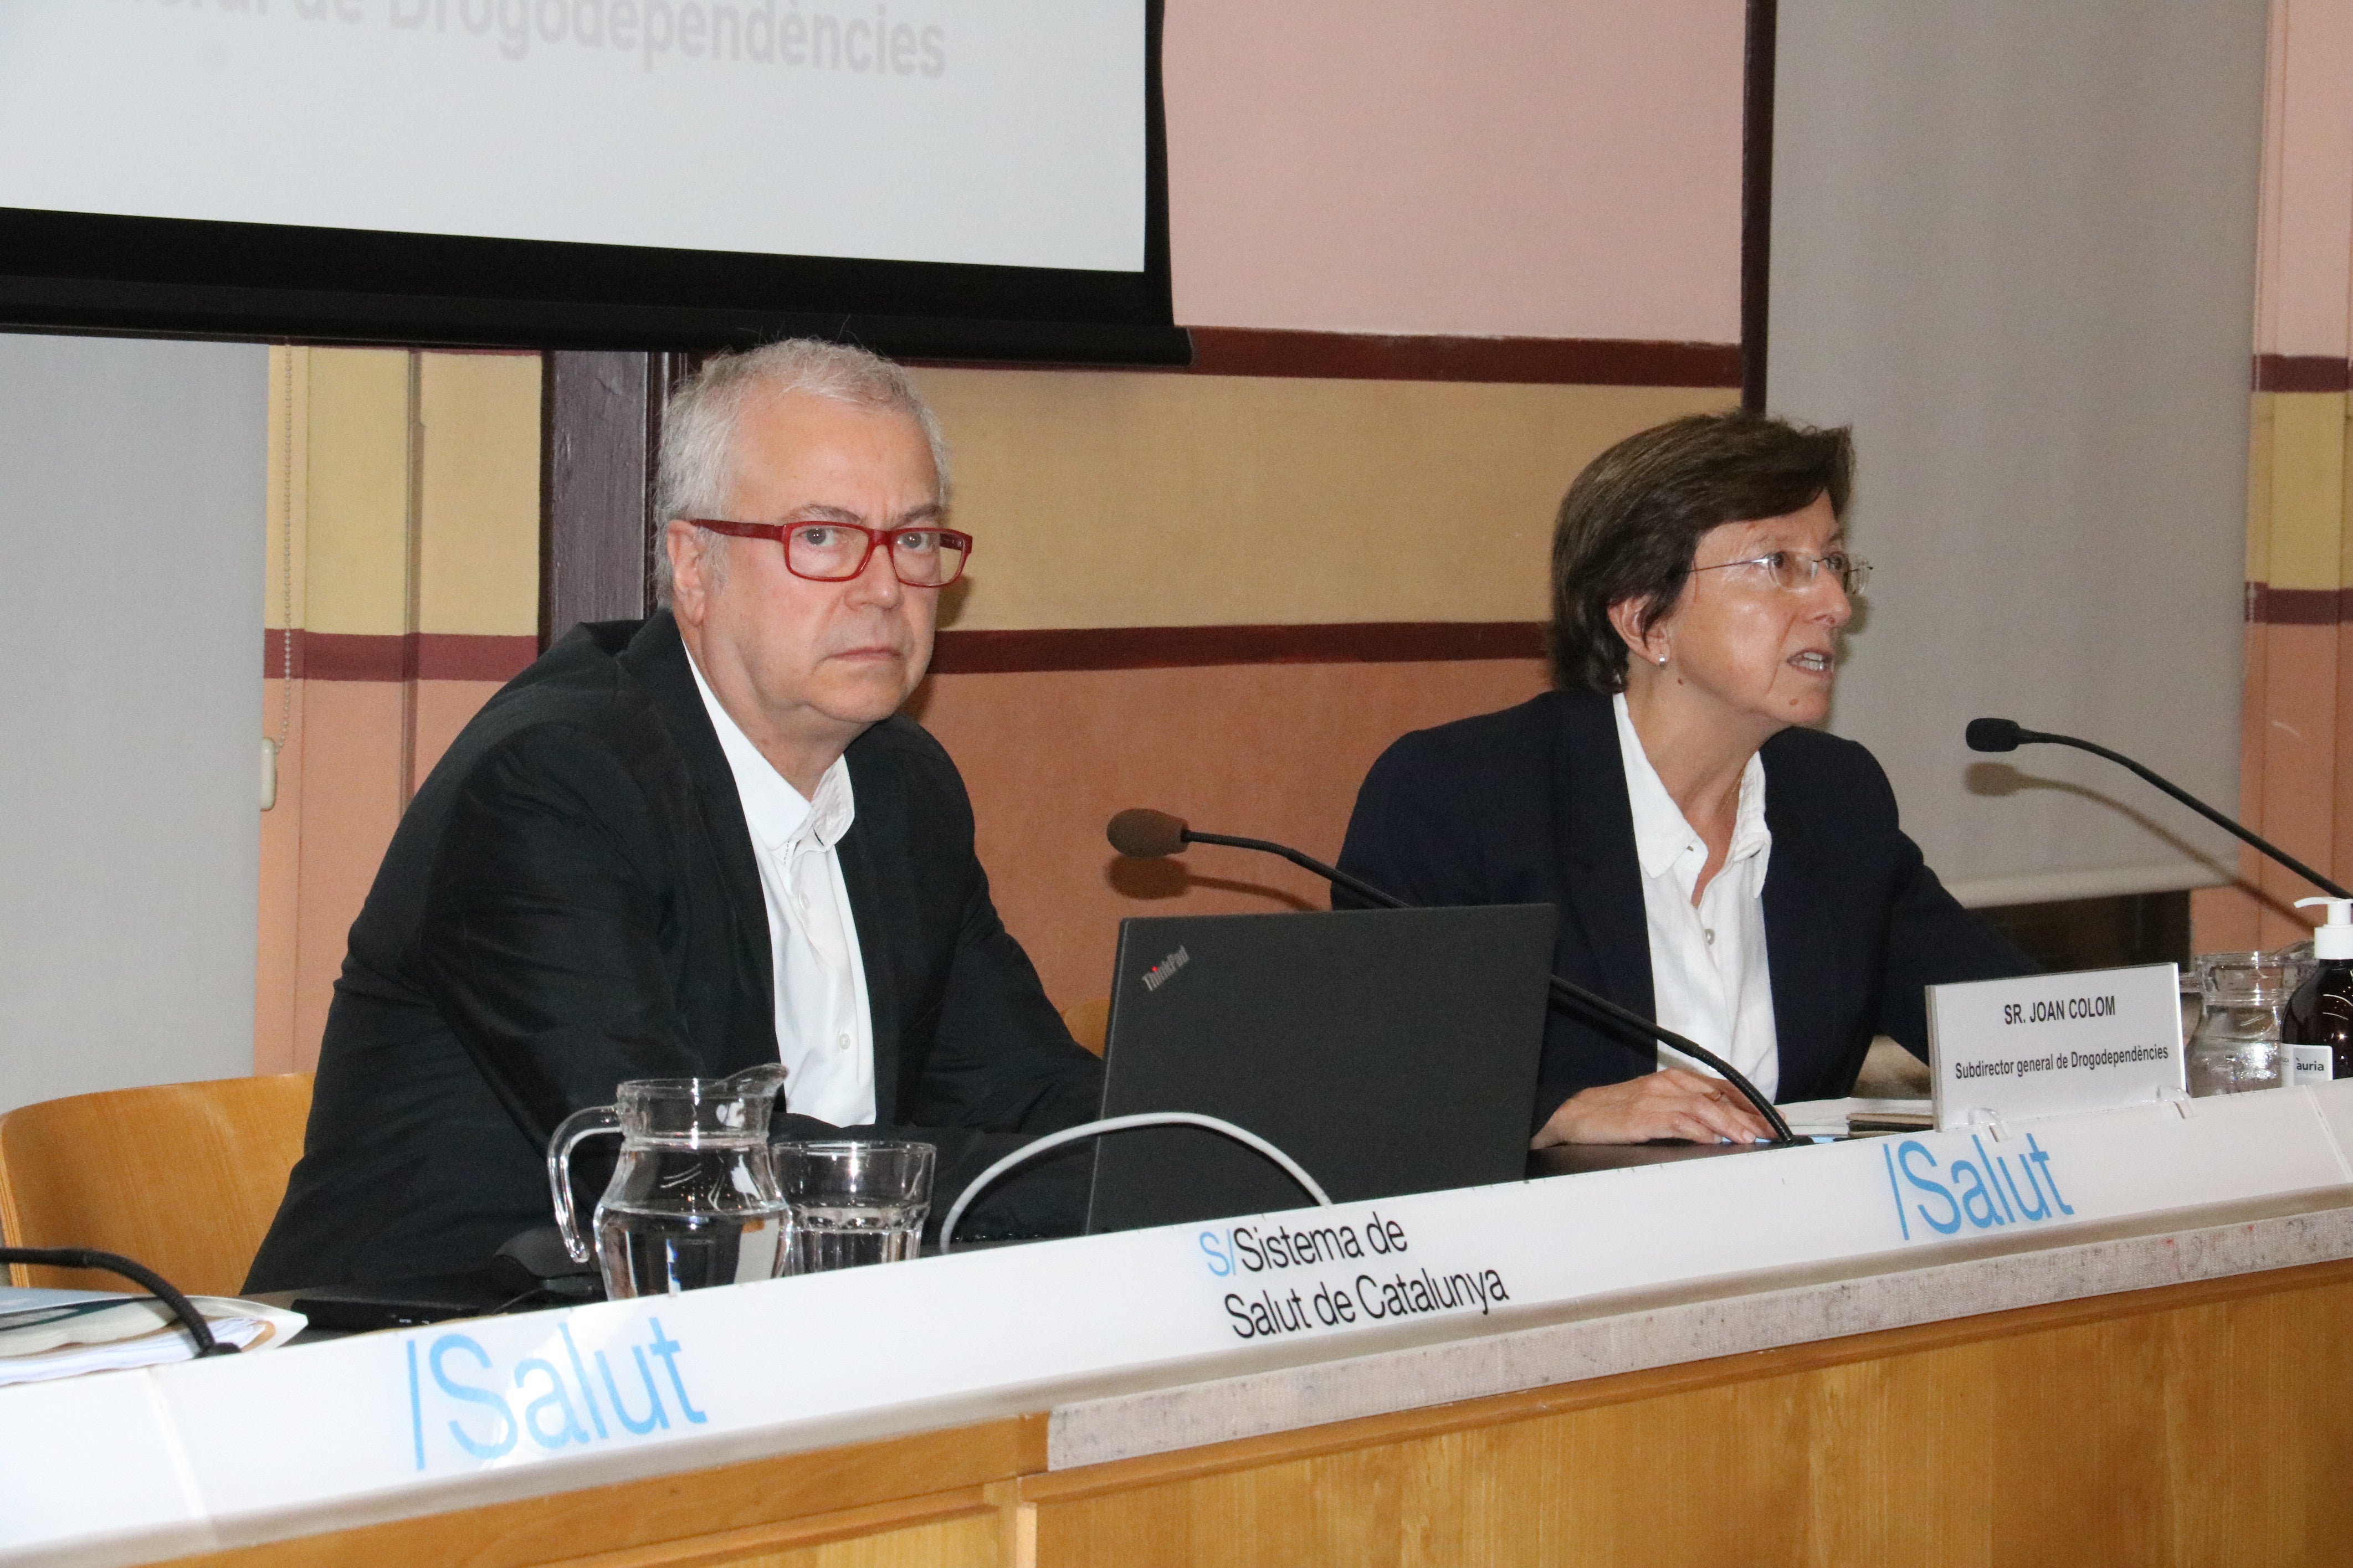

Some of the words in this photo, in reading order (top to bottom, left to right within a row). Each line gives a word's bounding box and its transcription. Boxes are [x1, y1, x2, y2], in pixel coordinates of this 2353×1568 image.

[1142, 944, 1190, 991] ThinkPad
[2004, 1003, 2026, 1025] SR.
[2029, 999, 2065, 1023] JOAN
[2069, 995, 2116, 1019] COLOM
[1955, 1059, 2014, 1079] Subdirector
[2017, 1053, 2054, 1078] general
[2056, 1053, 2069, 1070] de
[2071, 1043, 2169, 1071] Drogodependències
[1366, 1211, 1408, 1255] de
[1224, 1289, 1312, 1339] Salut
[1314, 1282, 1356, 1327] de
[1356, 1267, 1510, 1319] Catalunya
